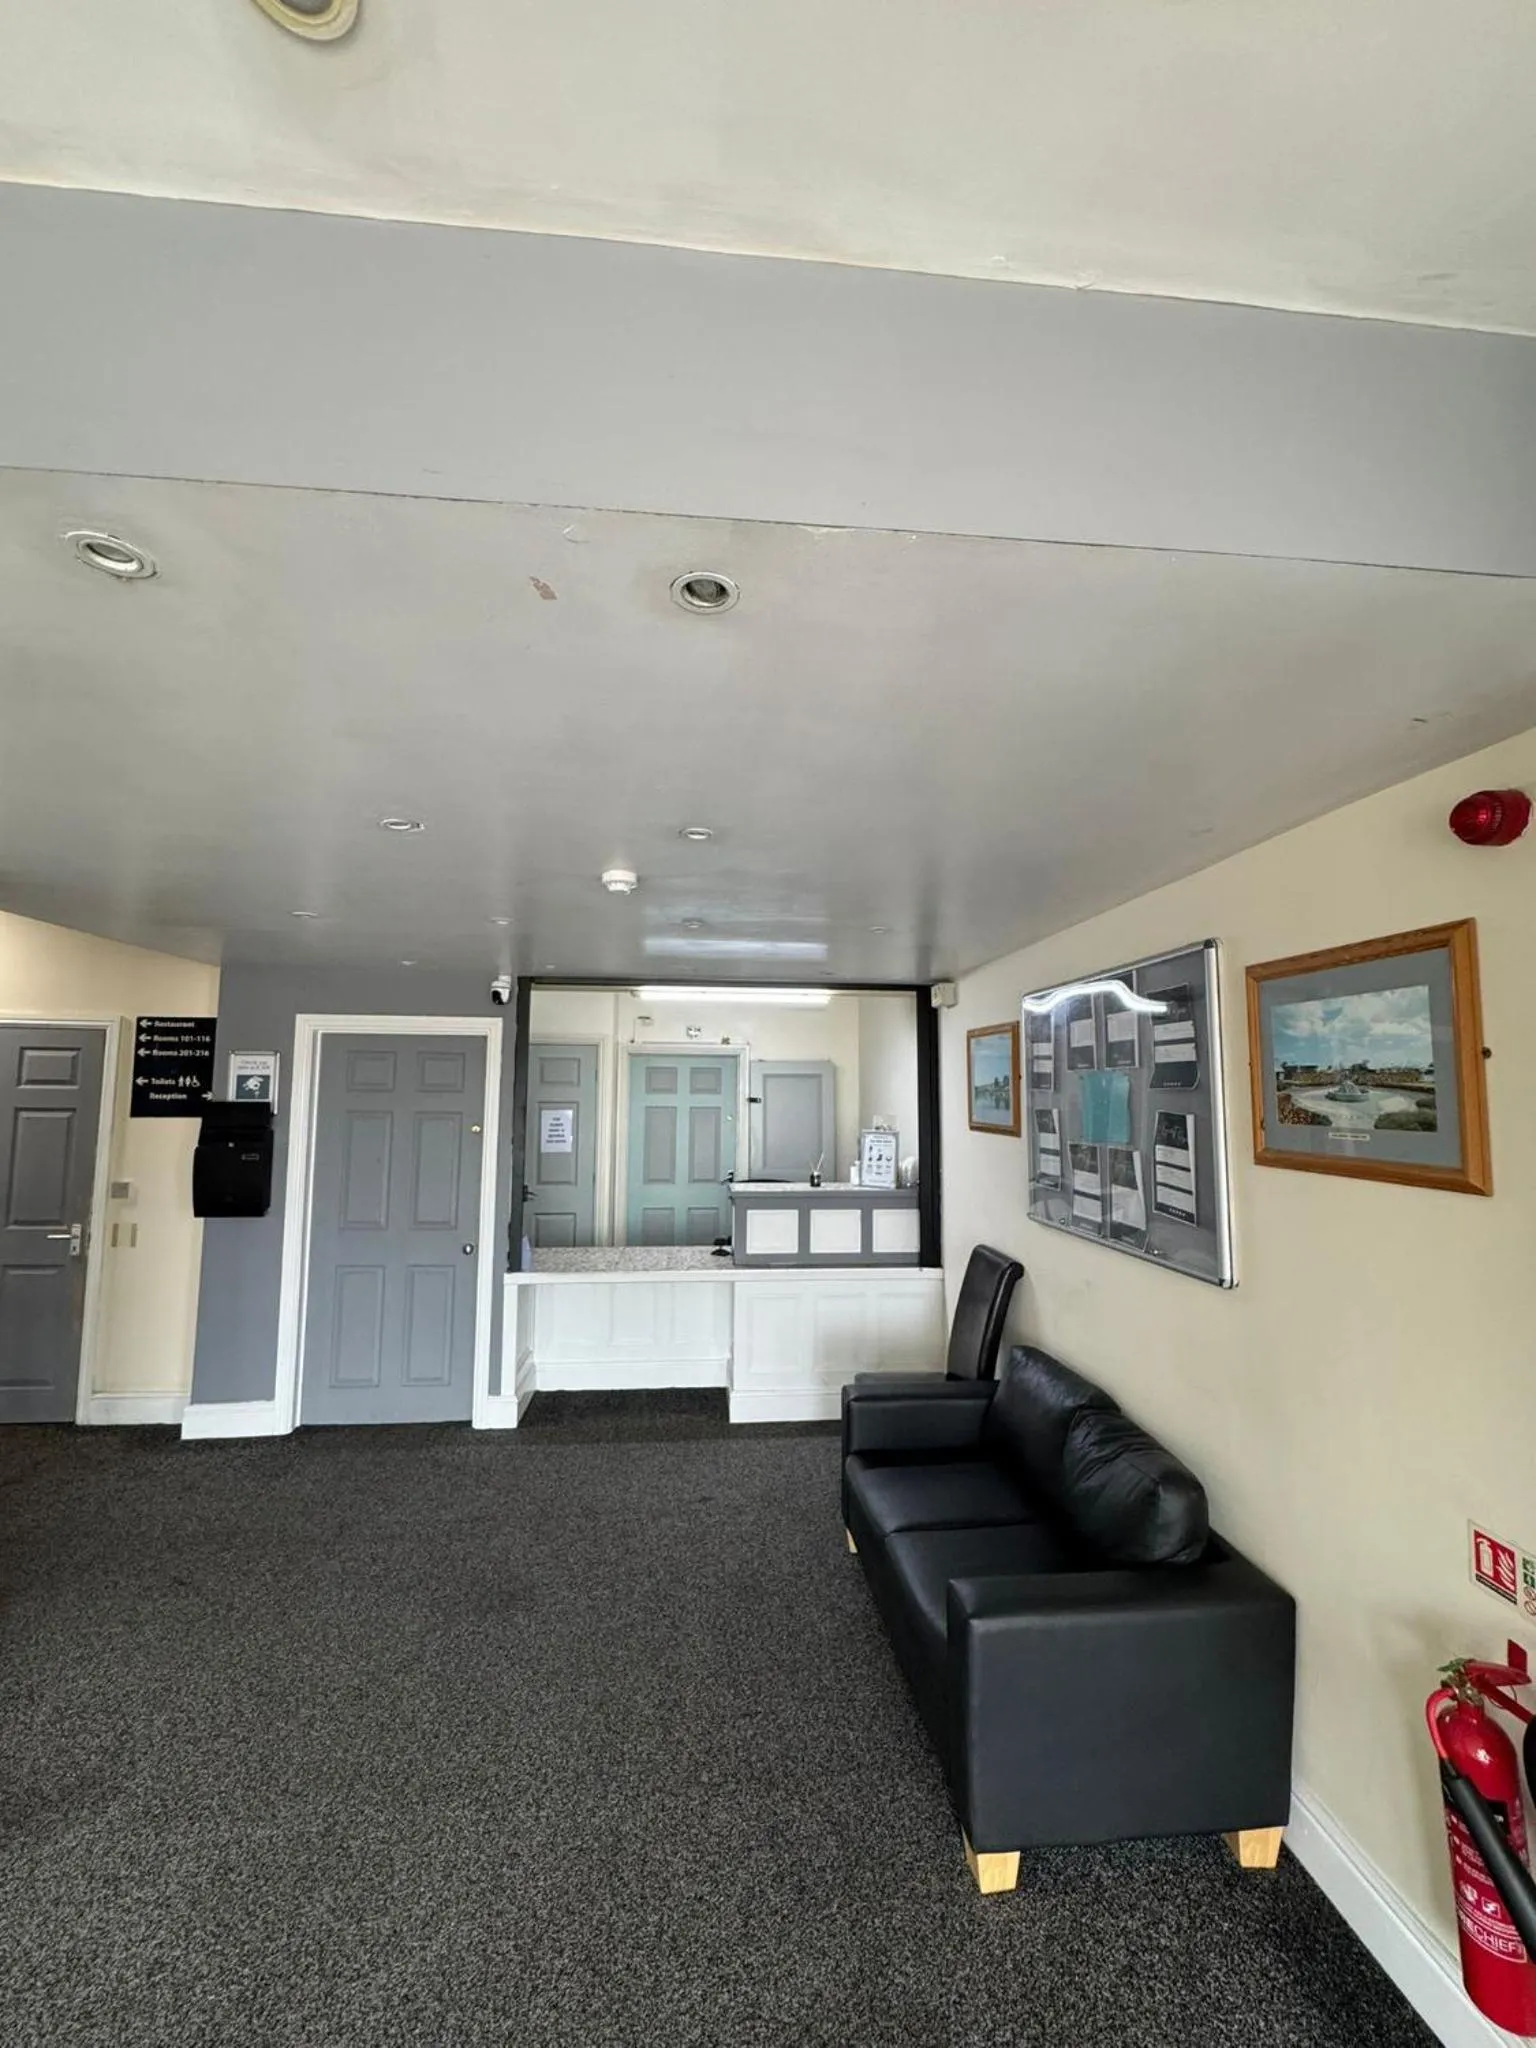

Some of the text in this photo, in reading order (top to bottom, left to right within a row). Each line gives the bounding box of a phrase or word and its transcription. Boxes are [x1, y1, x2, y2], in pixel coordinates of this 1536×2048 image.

[154, 1020, 195, 1028] Restaurant
[153, 1034, 179, 1042] Rooms
[151, 1077, 176, 1085] Toilets
[149, 1092, 188, 1101] Reception
